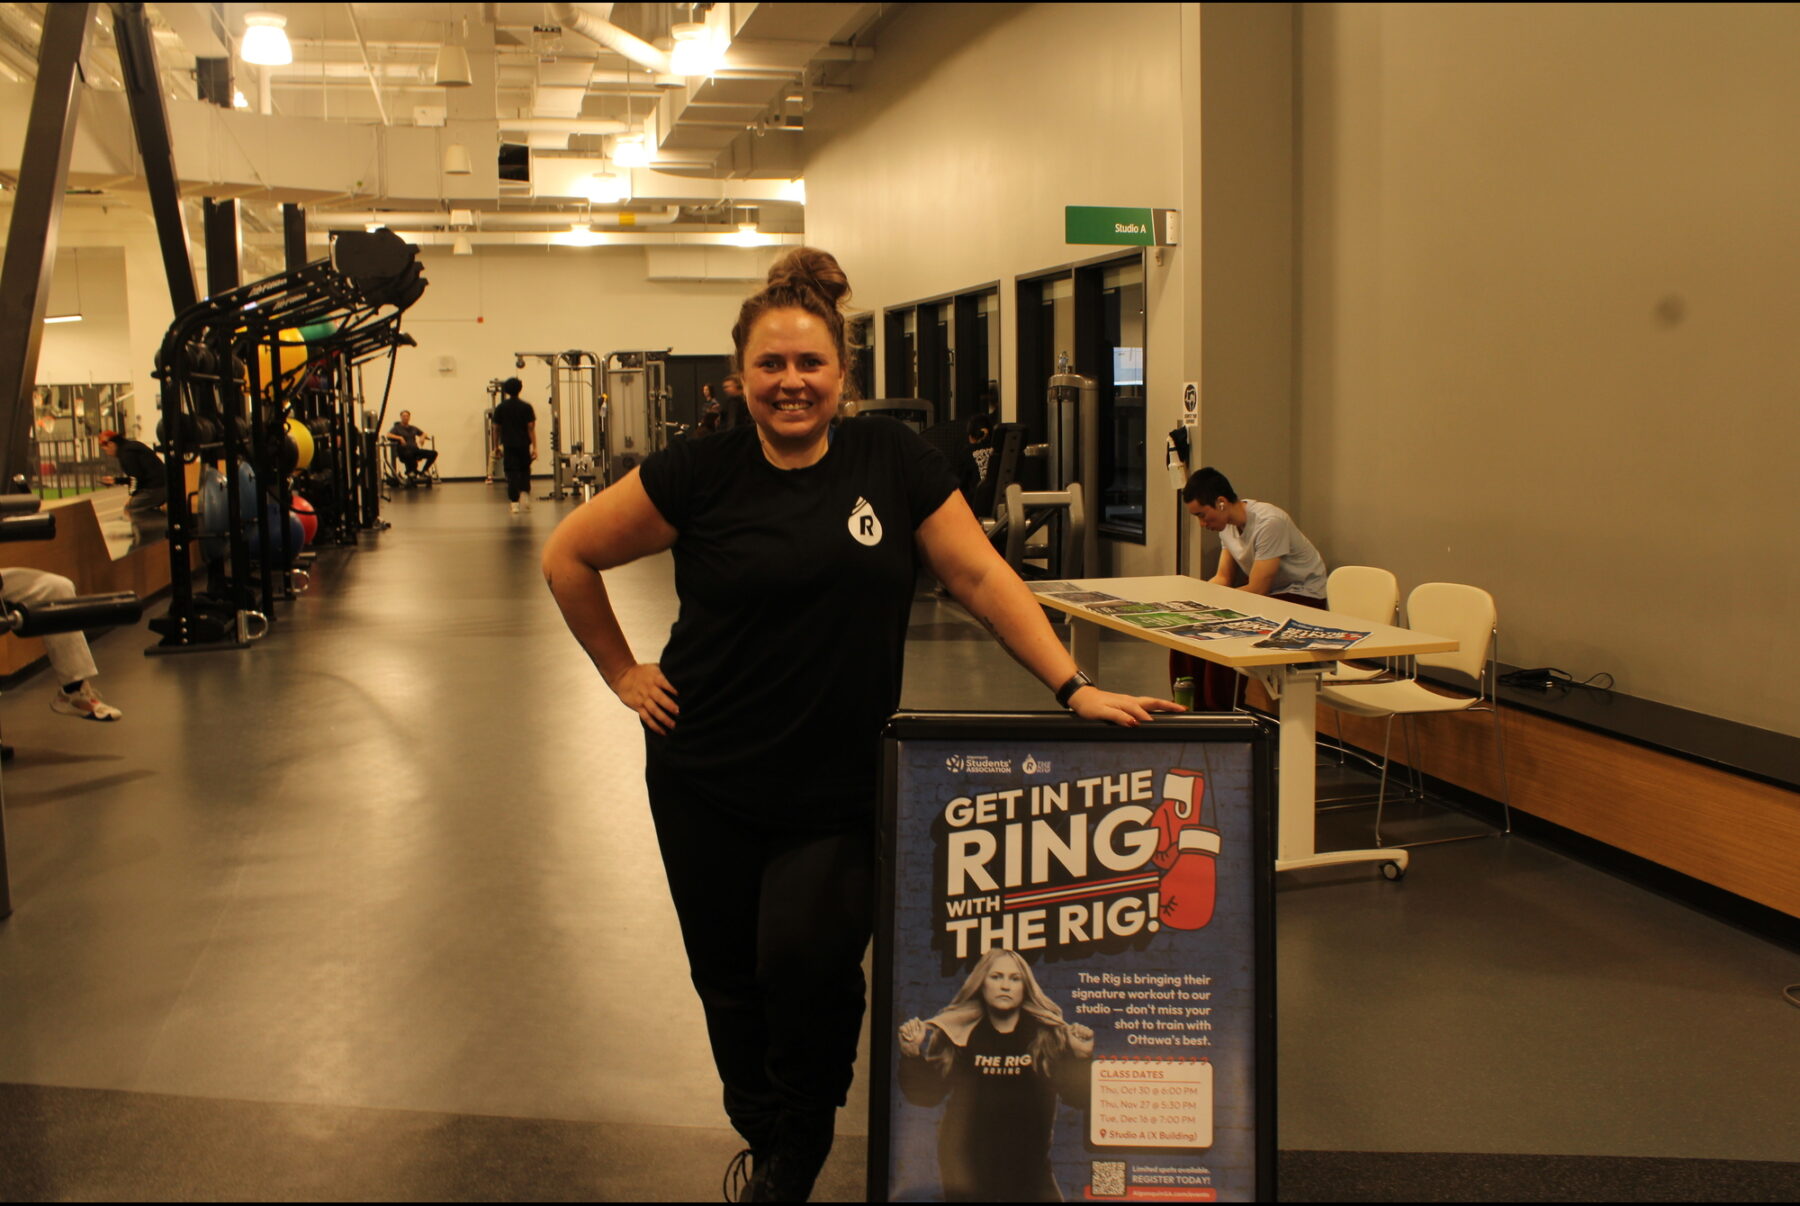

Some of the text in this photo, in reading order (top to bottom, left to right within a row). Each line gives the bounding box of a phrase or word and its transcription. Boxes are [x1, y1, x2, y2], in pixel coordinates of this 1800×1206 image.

[1115, 223, 1147, 233] Studio A
[860, 515, 874, 536] R
[966, 766, 1012, 774] ASSOCIATION
[945, 769, 1153, 827] GET IN THE
[947, 805, 1160, 896] RING
[946, 895, 1000, 918] WITH
[946, 892, 1160, 959] THE RIG!
[1078, 972, 1211, 987] The Rig is bringing their
[1071, 988, 1211, 1001] signature workout to our
[1076, 1003, 1111, 1014] studio
[1125, 1003, 1156, 1014] don't
[1158, 1004, 1183, 1015] miss
[1185, 1007, 1211, 1017] your
[1114, 1018, 1212, 1031] shot to train with
[1127, 1034, 1211, 1046] Ottawa's best.
[975, 1054, 1032, 1067] THE RIG
[1100, 1070, 1164, 1079] CLASS DATES
[1109, 1130, 1137, 1139] Studio
[1132, 1175, 1211, 1185] REGISTER TODAY!
